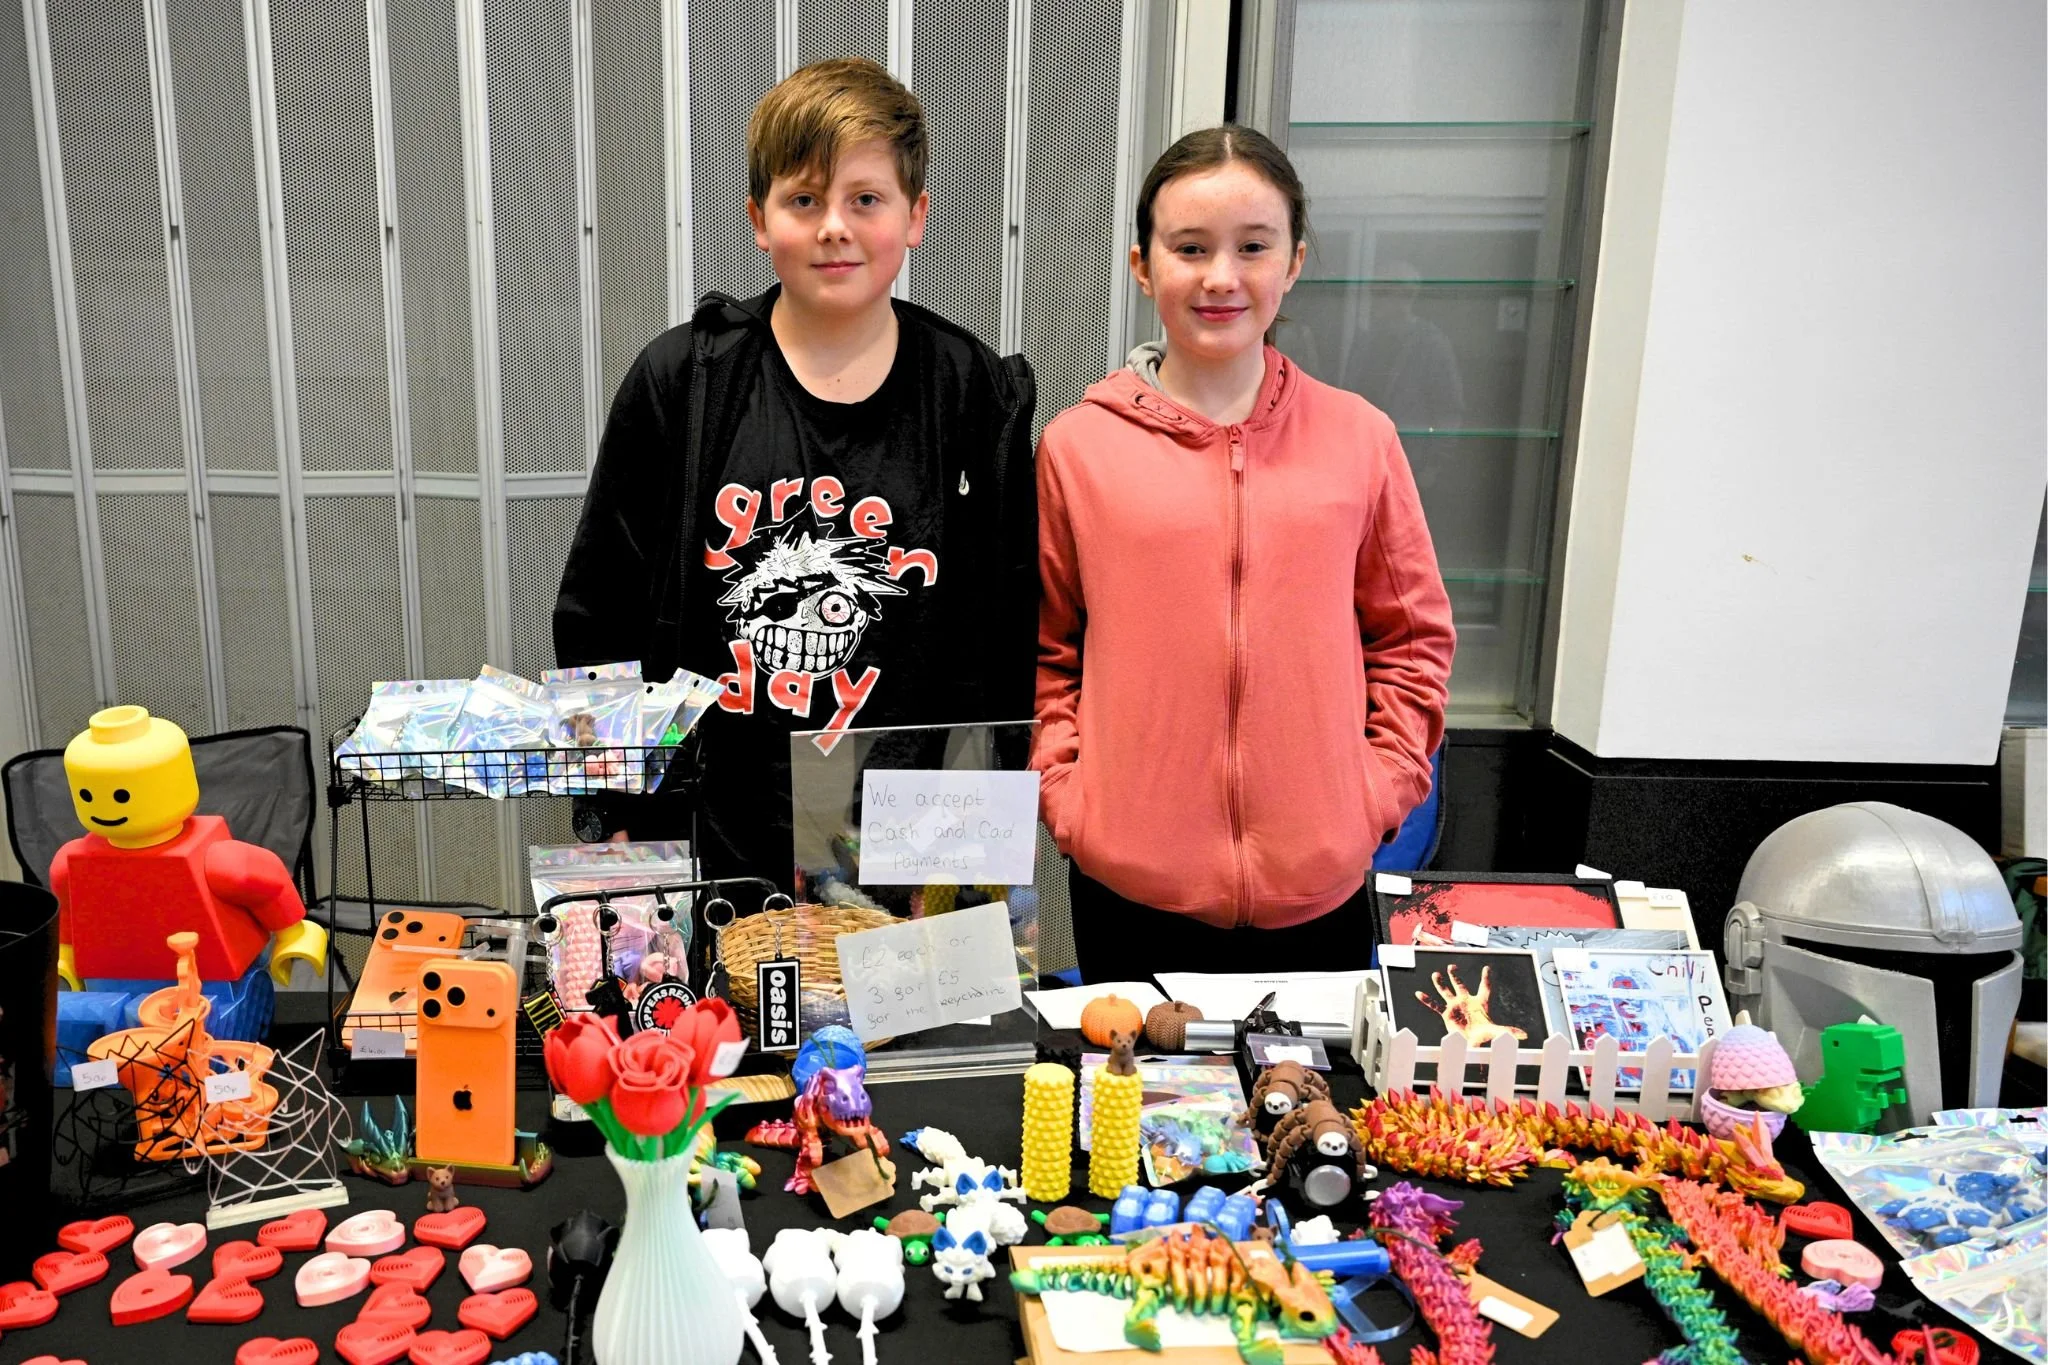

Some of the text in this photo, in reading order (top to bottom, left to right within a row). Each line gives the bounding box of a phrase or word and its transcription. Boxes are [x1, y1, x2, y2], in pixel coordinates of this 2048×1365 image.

[704, 476, 938, 587] green
[716, 639, 881, 756] day
[868, 782, 985, 812] We accept
[867, 821, 920, 843] Cash
[934, 821, 967, 839] and
[894, 851, 969, 876] Payments
[897, 944, 936, 961] each
[949, 936, 975, 947] or
[868, 986, 884, 1004] 3
[938, 969, 960, 985] £5
[641, 988, 668, 1029] EPPERS
[770, 970, 793, 1044] oasis
[905, 1007, 928, 1017] the
[214, 1084, 237, 1095] 50p
